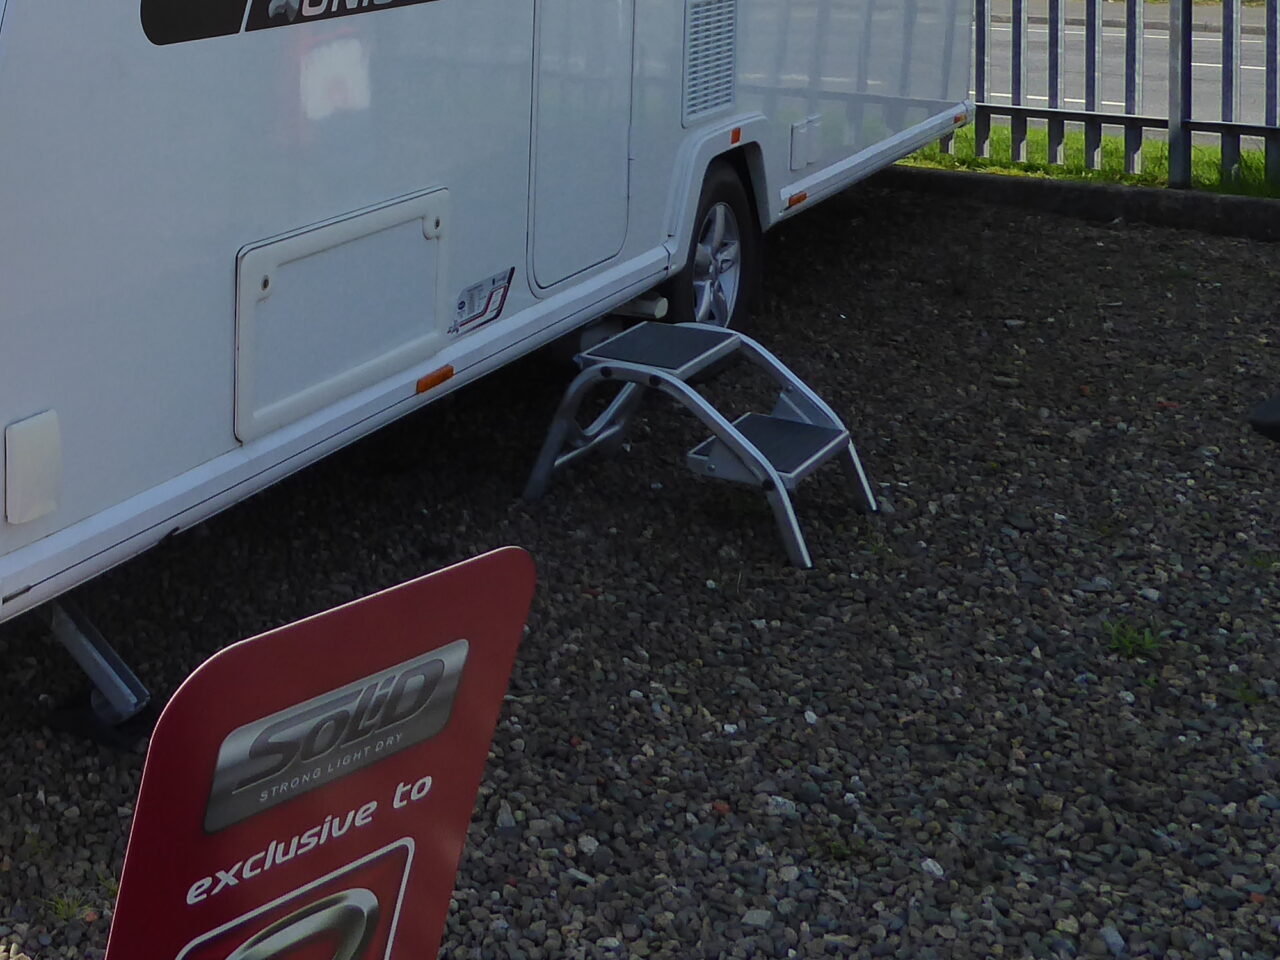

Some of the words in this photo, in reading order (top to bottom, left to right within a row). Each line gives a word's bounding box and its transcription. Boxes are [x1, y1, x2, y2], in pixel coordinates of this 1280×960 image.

[259, 767, 321, 802] STRONG
[327, 745, 371, 773] LIGHT
[375, 732, 403, 753] DRY
[186, 800, 378, 906] exclusive
[393, 775, 433, 809] to
